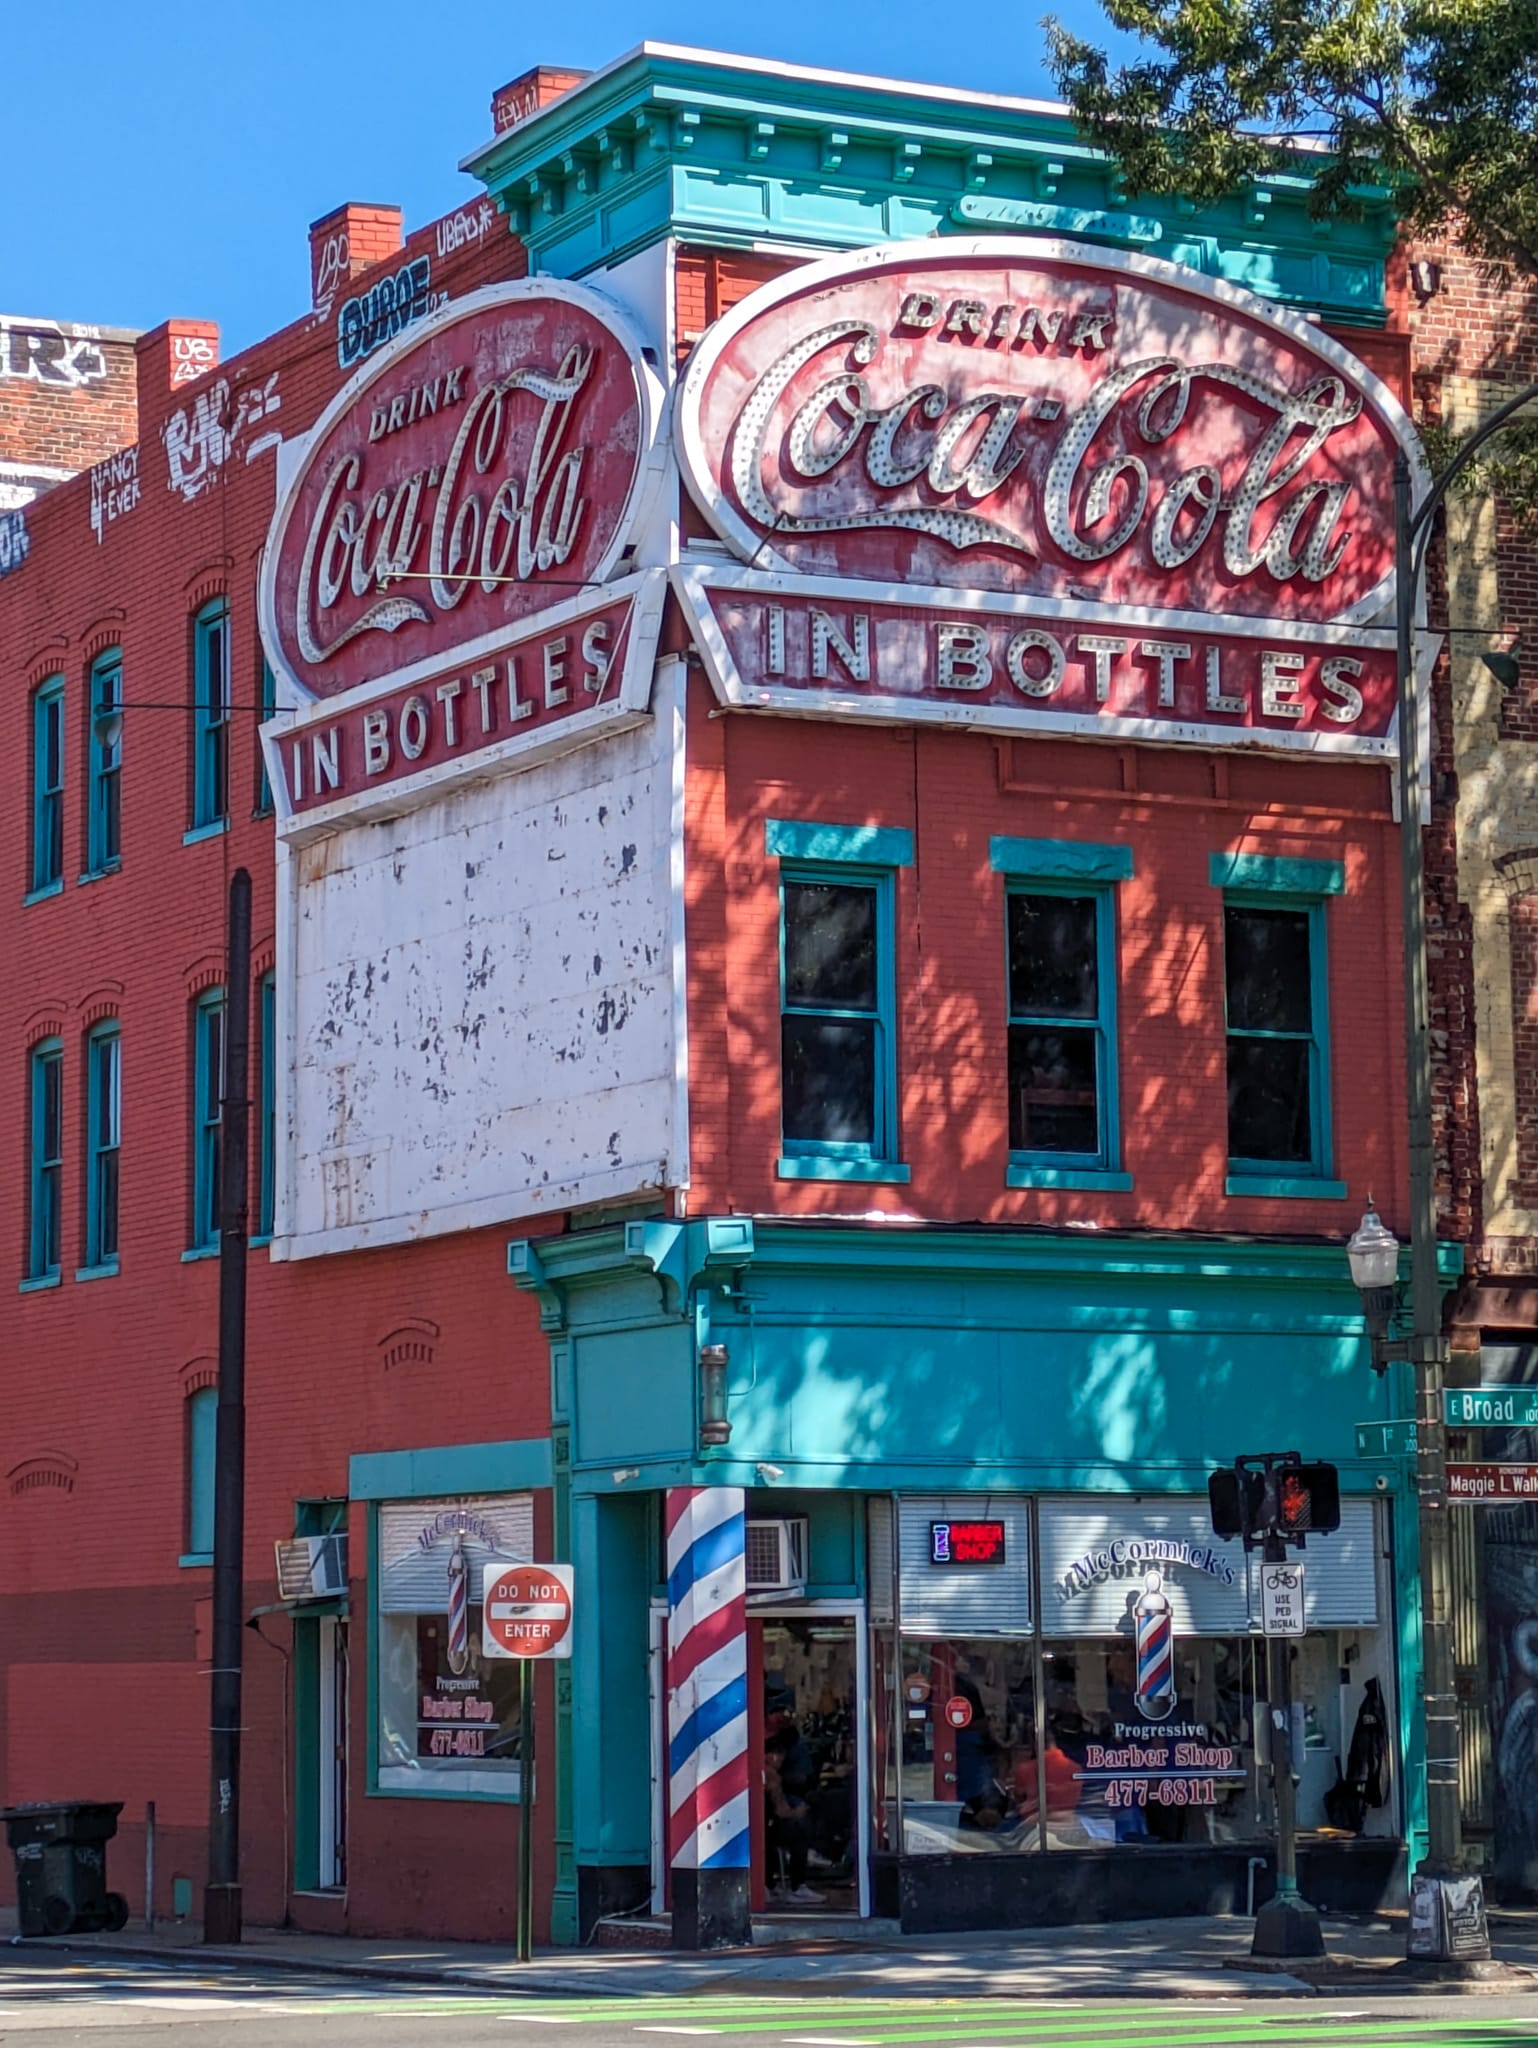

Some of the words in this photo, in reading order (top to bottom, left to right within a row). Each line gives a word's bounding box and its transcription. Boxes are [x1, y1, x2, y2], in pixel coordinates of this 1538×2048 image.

[902, 293, 1116, 351] DRINK
[368, 365, 465, 443] DRINK
[731, 320, 1363, 582] Coca-Cola
[297, 343, 594, 664] Coca-Cola
[768, 607, 870, 681] IN
[934, 621, 1364, 724] BOTTLES
[293, 725, 340, 801] IN
[363, 620, 608, 776] BOTTLES
[1451, 1400, 1459, 1416] E
[1462, 1394, 1514, 1421] Broad
[1358, 1431, 1366, 1448] N
[1450, 1475, 1495, 1497] Maggie
[1500, 1475, 1511, 1493] L
[955, 1542, 996, 1560] SHOP
[1071, 1538, 1236, 1589] McCormick's
[498, 1585, 519, 1599] DO
[529, 1585, 560, 1600] NOT
[1275, 1594, 1291, 1605] USE
[1269, 1619, 1298, 1629] SIGNAL
[1275, 1606, 1291, 1617] PED
[505, 1623, 551, 1639] ENTER
[422, 1695, 462, 1718] Barber
[464, 1695, 493, 1723] Shop
[1114, 1721, 1206, 1740] Progressive
[1086, 1745, 1169, 1768] Barber
[1175, 1743, 1233, 1769] Shop
[1104, 1778, 1217, 1807] 477-6811
